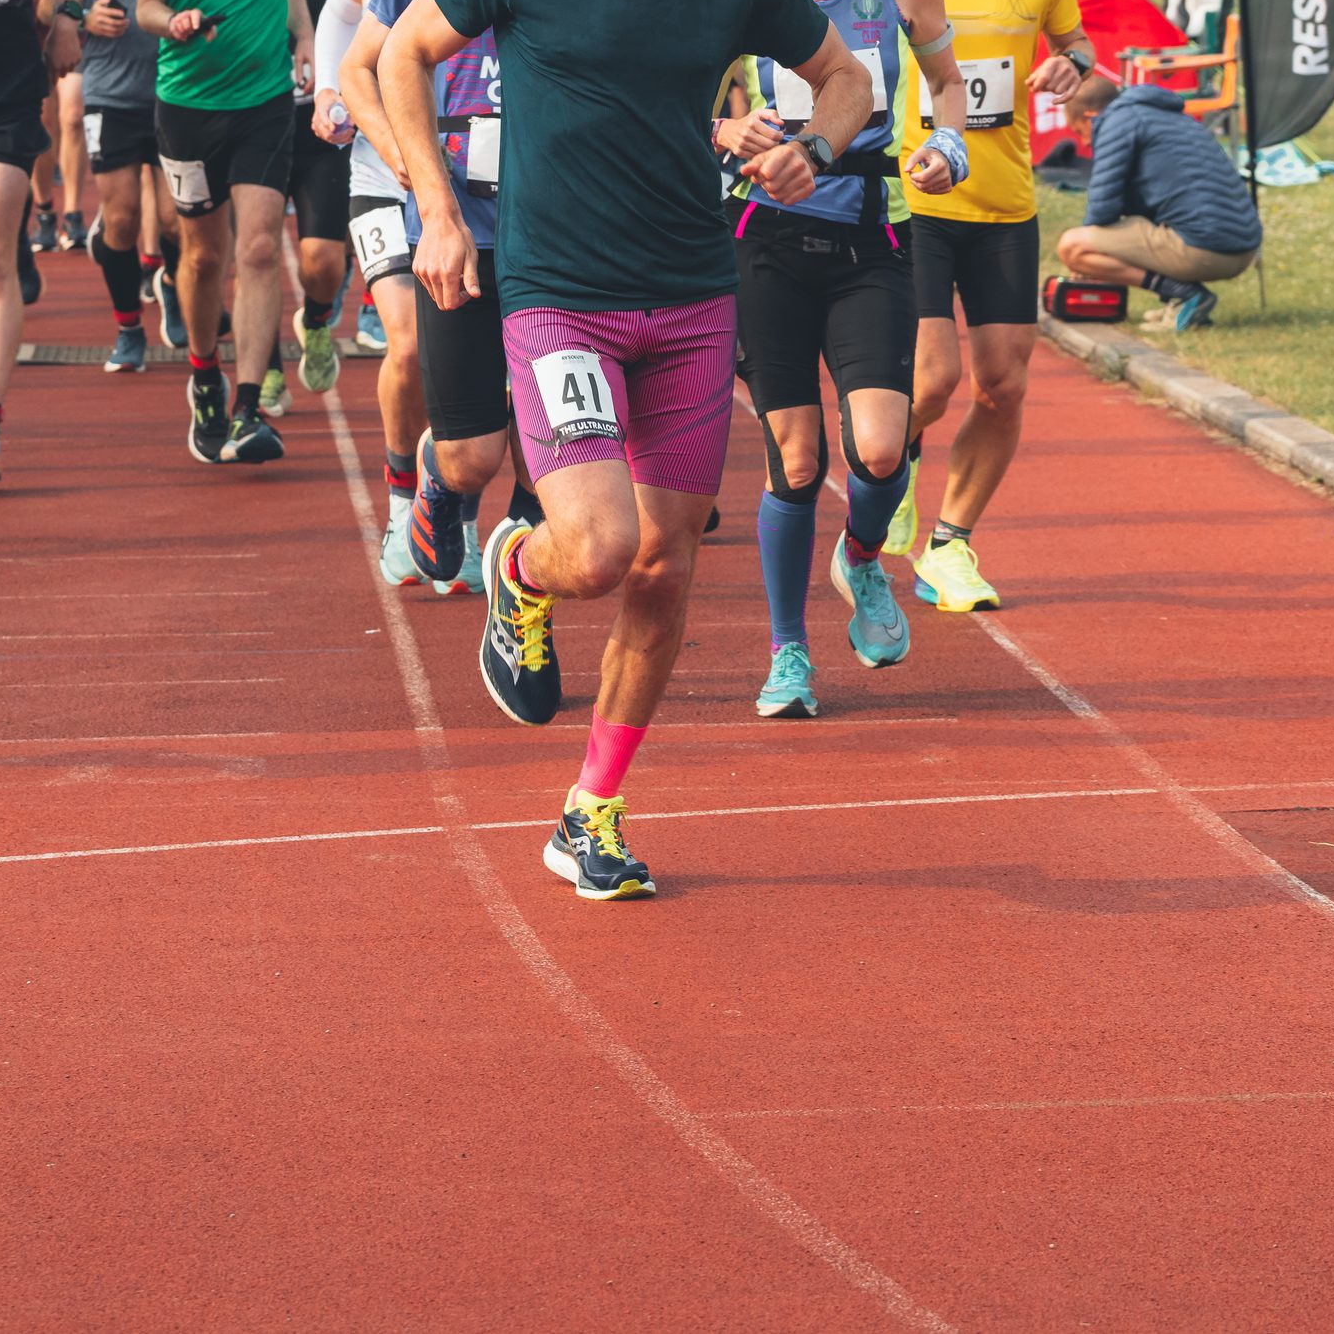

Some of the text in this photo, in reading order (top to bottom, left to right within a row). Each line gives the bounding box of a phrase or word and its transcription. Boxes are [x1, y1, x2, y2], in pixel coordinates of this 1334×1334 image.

[358, 227, 386, 262] 13
[561, 372, 603, 414] 41
[559, 423, 577, 436] THE
[576, 420, 603, 431] ULTRA
